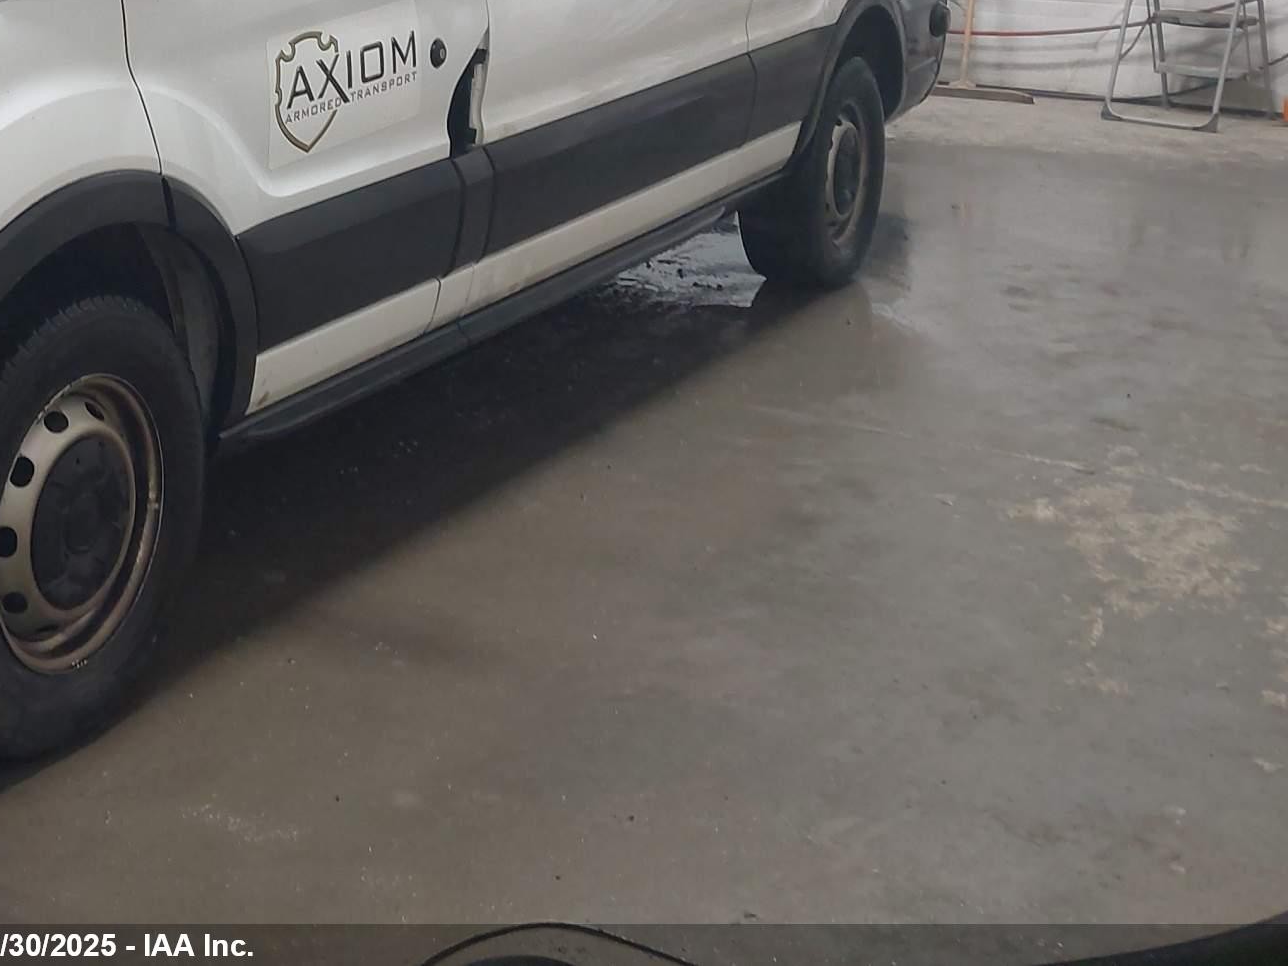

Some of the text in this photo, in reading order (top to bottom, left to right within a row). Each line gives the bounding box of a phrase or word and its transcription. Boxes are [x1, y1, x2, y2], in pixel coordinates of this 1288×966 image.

[285, 72, 417, 124] ARMORED TRANSPORT
[287, 31, 417, 109] AXIOM
